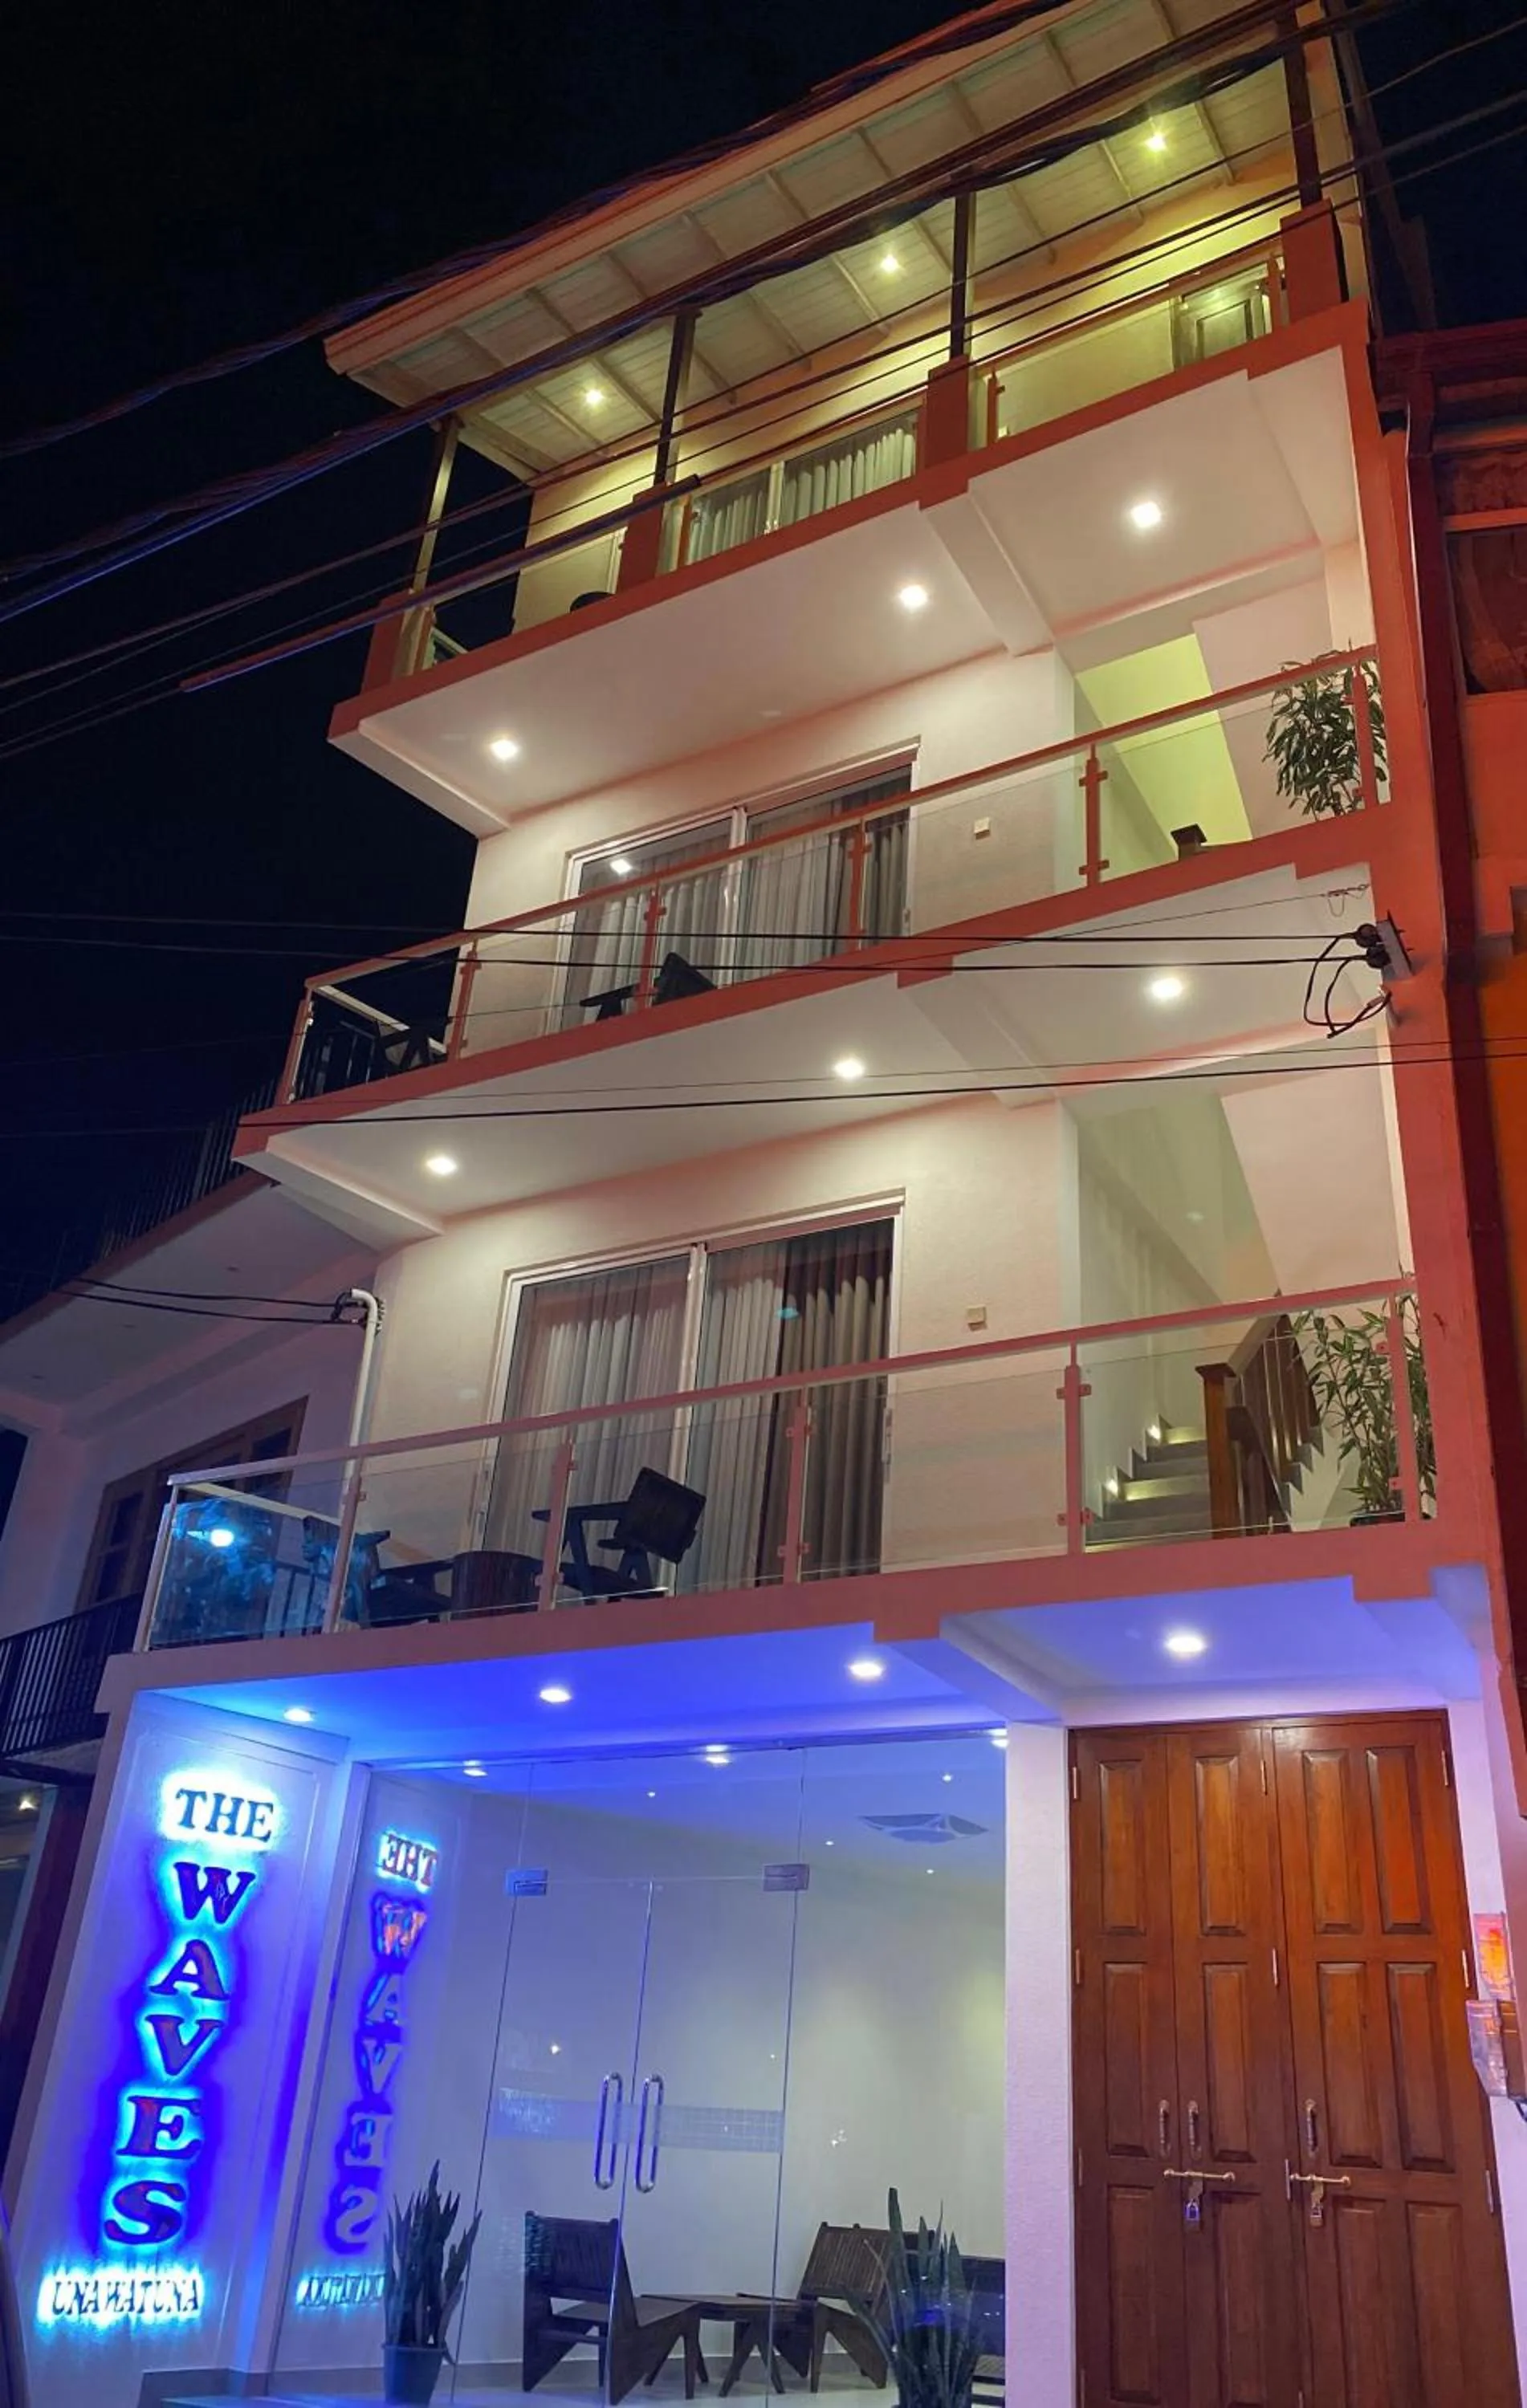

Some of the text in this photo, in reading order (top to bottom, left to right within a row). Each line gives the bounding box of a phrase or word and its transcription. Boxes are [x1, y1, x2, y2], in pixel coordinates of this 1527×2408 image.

[175, 1788, 275, 1843] THE
[104, 1861, 257, 2245] WAVES
[52, 2279, 199, 2316] UNAWATUNA
